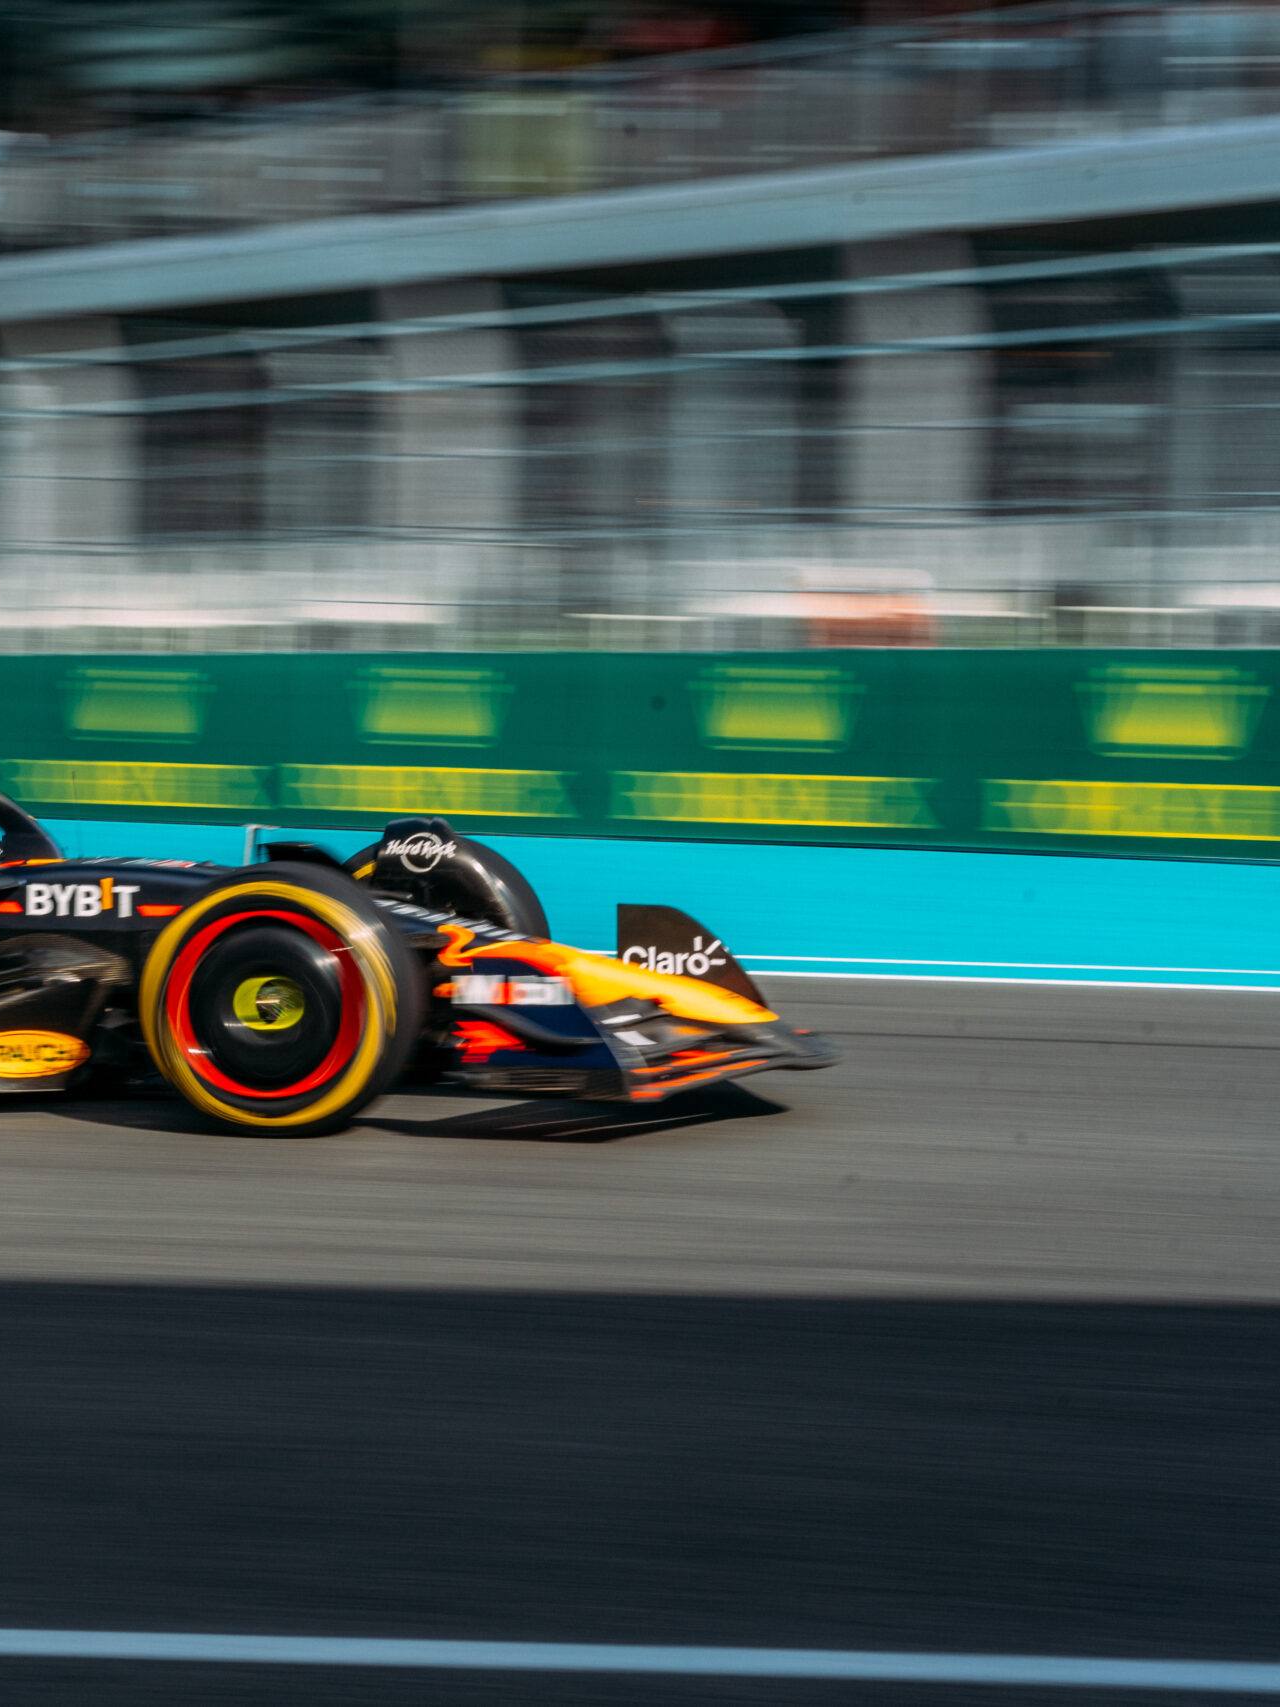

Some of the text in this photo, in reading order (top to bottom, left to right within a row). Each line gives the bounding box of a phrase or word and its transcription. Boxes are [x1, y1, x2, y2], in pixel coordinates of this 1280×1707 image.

[385, 839, 424, 856] Hard
[25, 877, 140, 918] BYBIT
[622, 945, 711, 976] Claro
